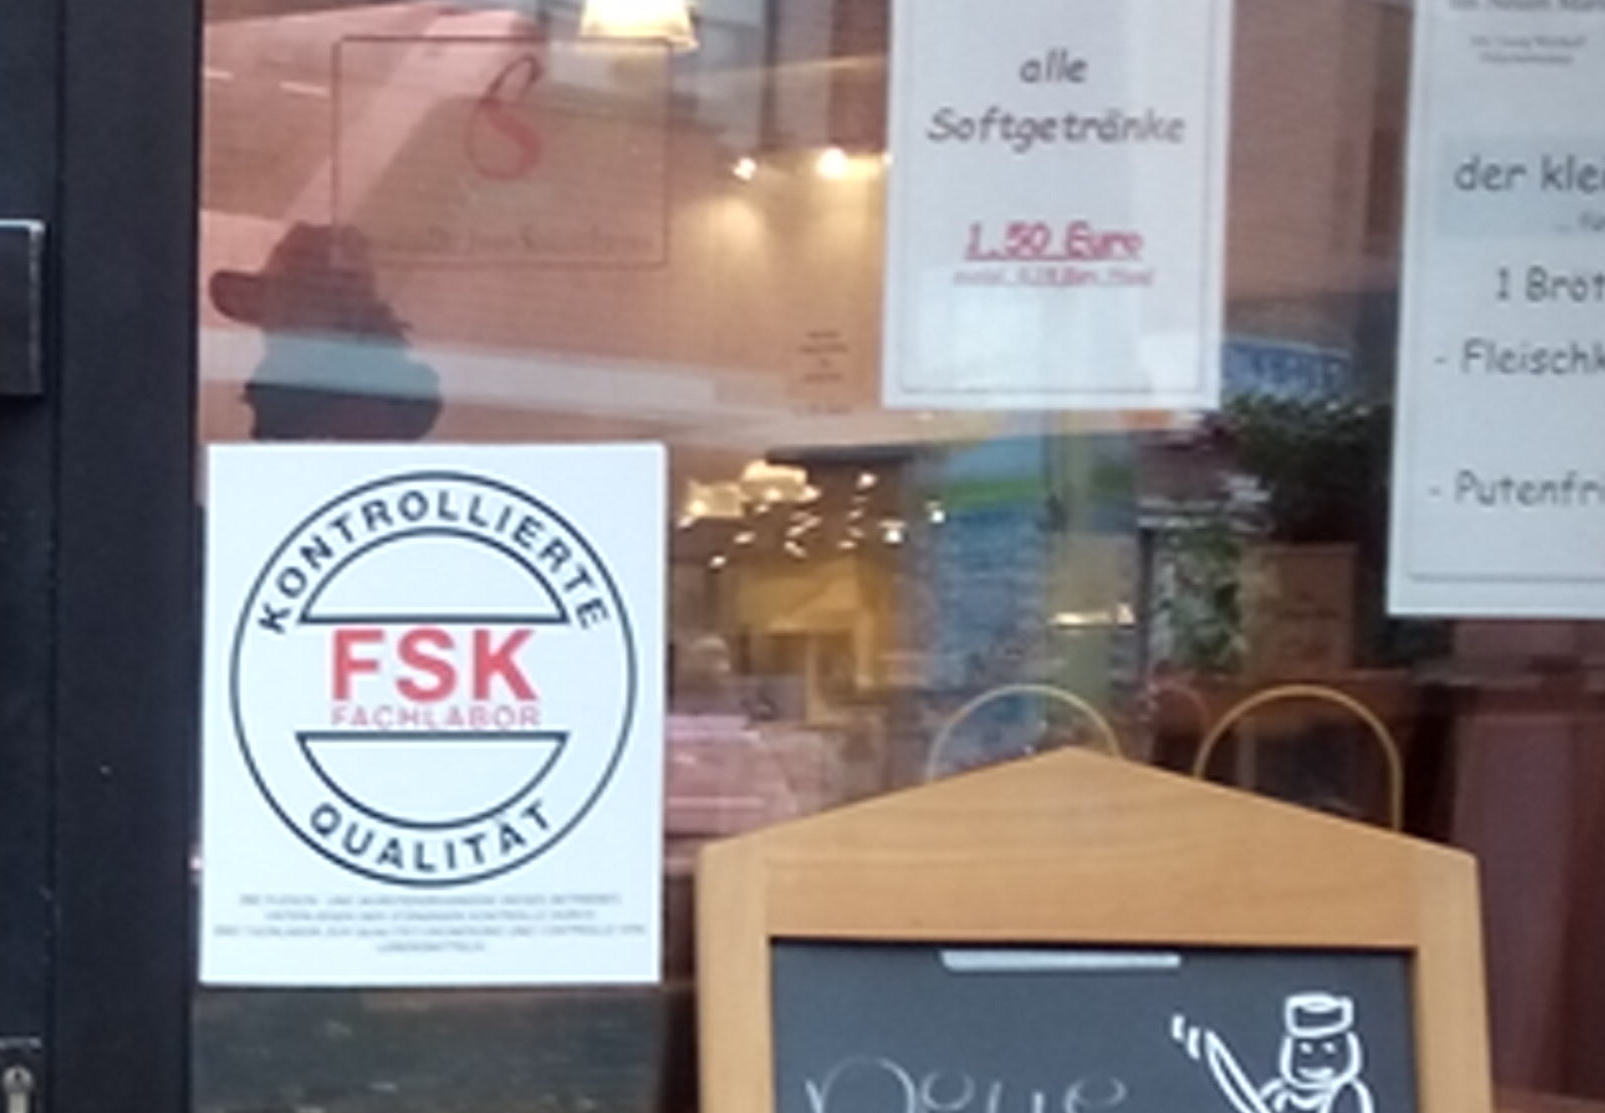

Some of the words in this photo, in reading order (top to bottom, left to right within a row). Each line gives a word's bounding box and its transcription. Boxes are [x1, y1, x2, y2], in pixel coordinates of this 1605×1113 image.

[1017, 48, 1089, 84] alle
[926, 106, 1186, 154] Softgetränke
[1453, 153, 1528, 192] der
[1540, 153, 1605, 194] kle
[1066, 219, 1144, 261] Euro
[1496, 266, 1509, 301] 1
[257, 488, 611, 636] KONTROLLIERTE
[331, 626, 542, 702] FSK
[330, 704, 542, 728] FACHLABOR
[308, 798, 552, 873] QUALITÄT
